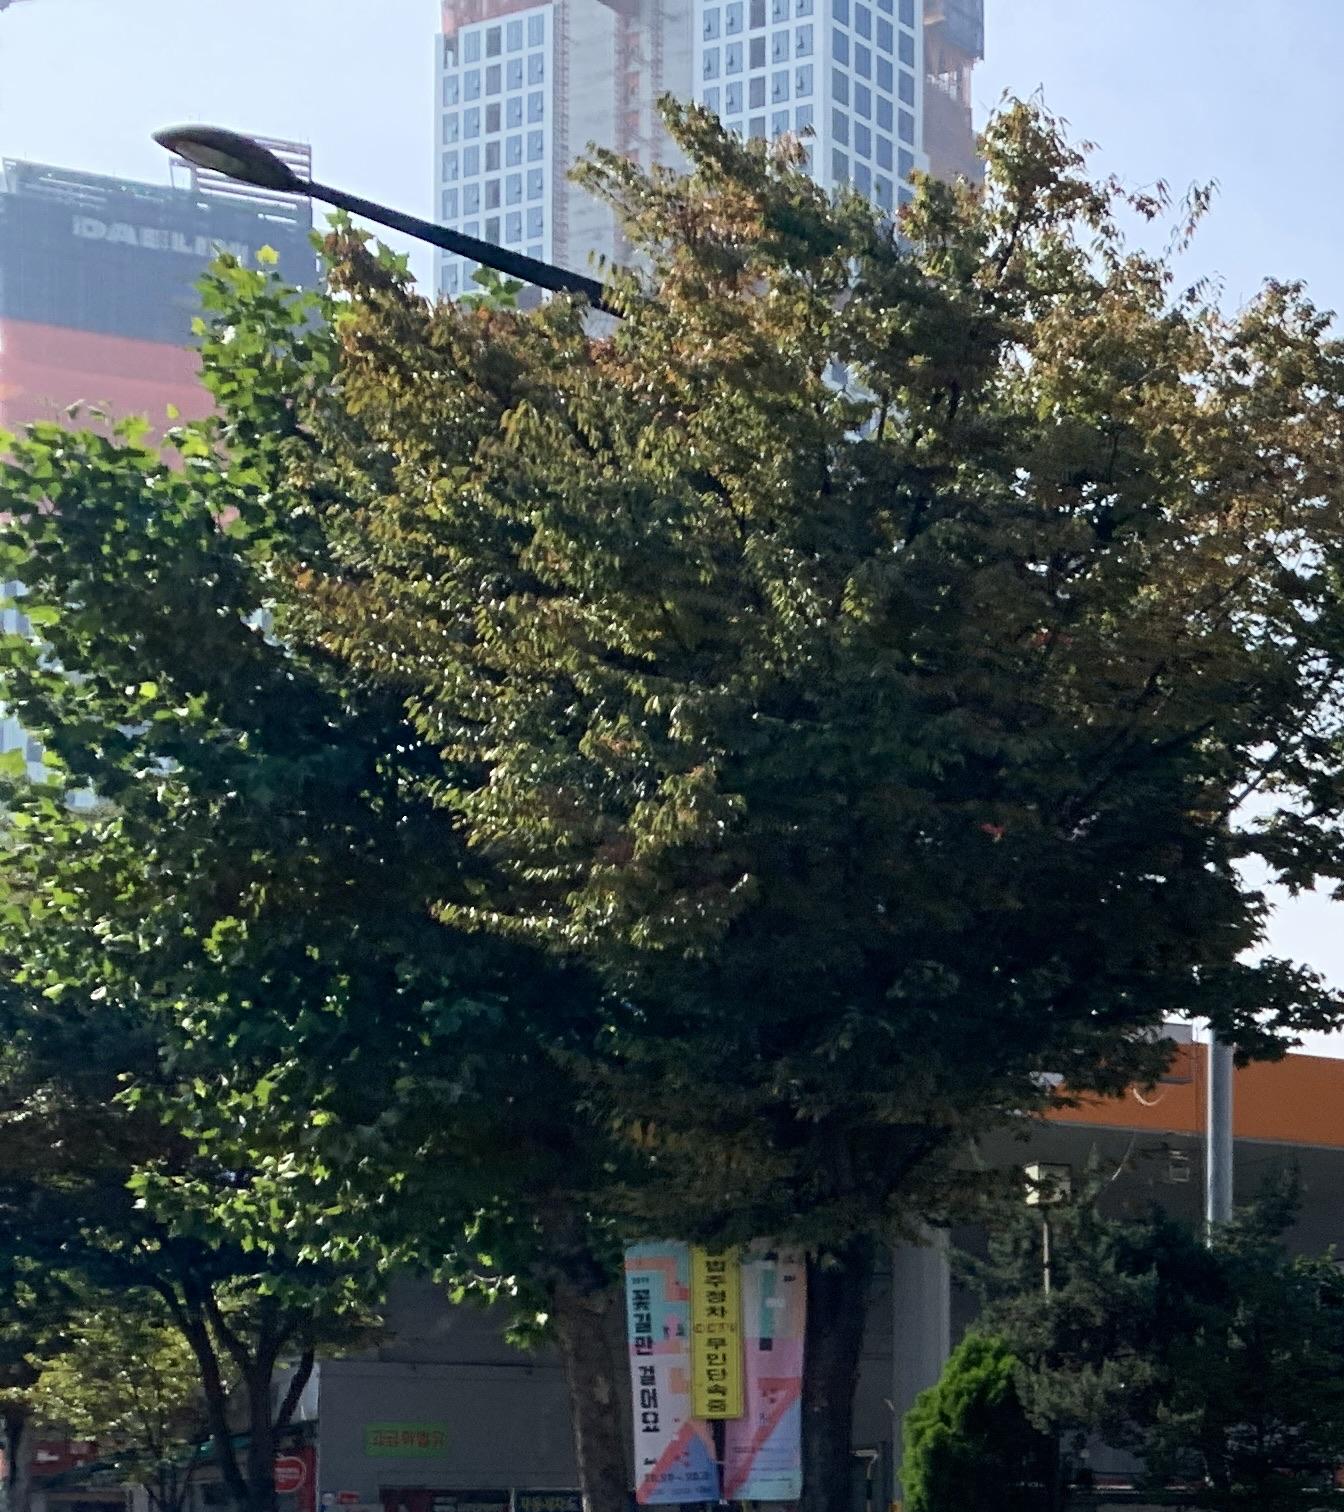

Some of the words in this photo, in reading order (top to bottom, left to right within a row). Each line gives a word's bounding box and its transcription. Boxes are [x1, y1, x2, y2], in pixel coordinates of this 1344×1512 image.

[632, 1288, 654, 1356] 꽃길만
[638, 1365, 661, 1433] 걸어요
[705, 1338, 728, 1412] 무인단속중
